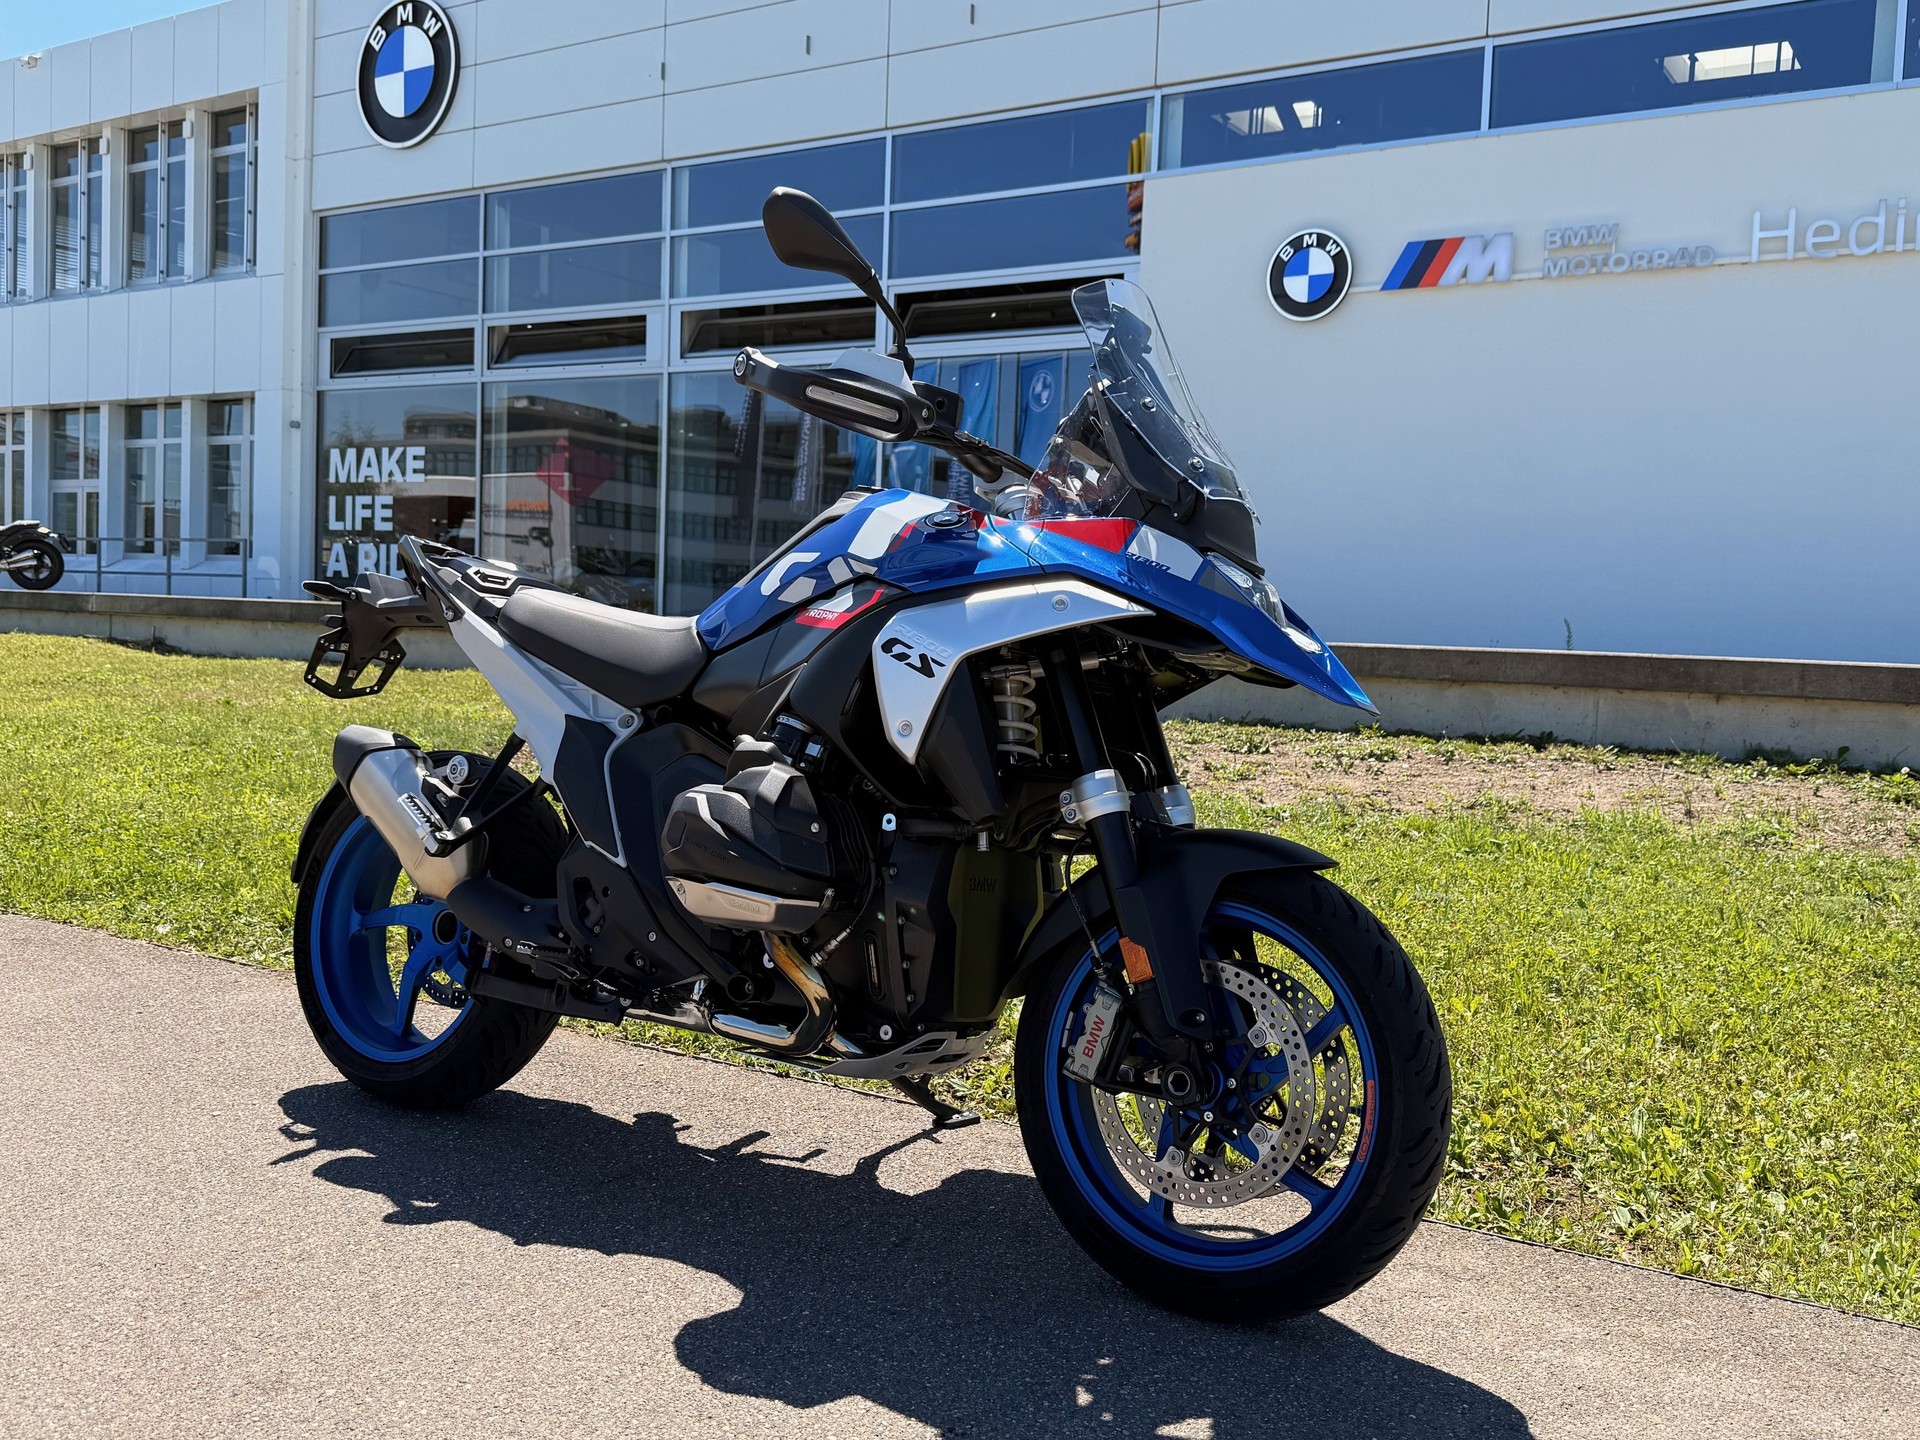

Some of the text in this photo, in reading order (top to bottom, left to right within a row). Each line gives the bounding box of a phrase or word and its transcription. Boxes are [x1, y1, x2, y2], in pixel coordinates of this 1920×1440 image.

[369, 2, 441, 52] BMW
[1279, 233, 1341, 262] BMW
[1544, 223, 1619, 250] BMW
[1751, 197, 1920, 263] Hedi
[1543, 245, 1715, 279] MOTORRAD
[329, 446, 426, 483] MAKE
[329, 495, 393, 531] LIFE
[326, 543, 350, 578] A
[805, 609, 840, 620] TROPHY
[881, 637, 947, 679] GS
[969, 876, 997, 893] BMW
[1082, 1015, 1105, 1058] BMW
